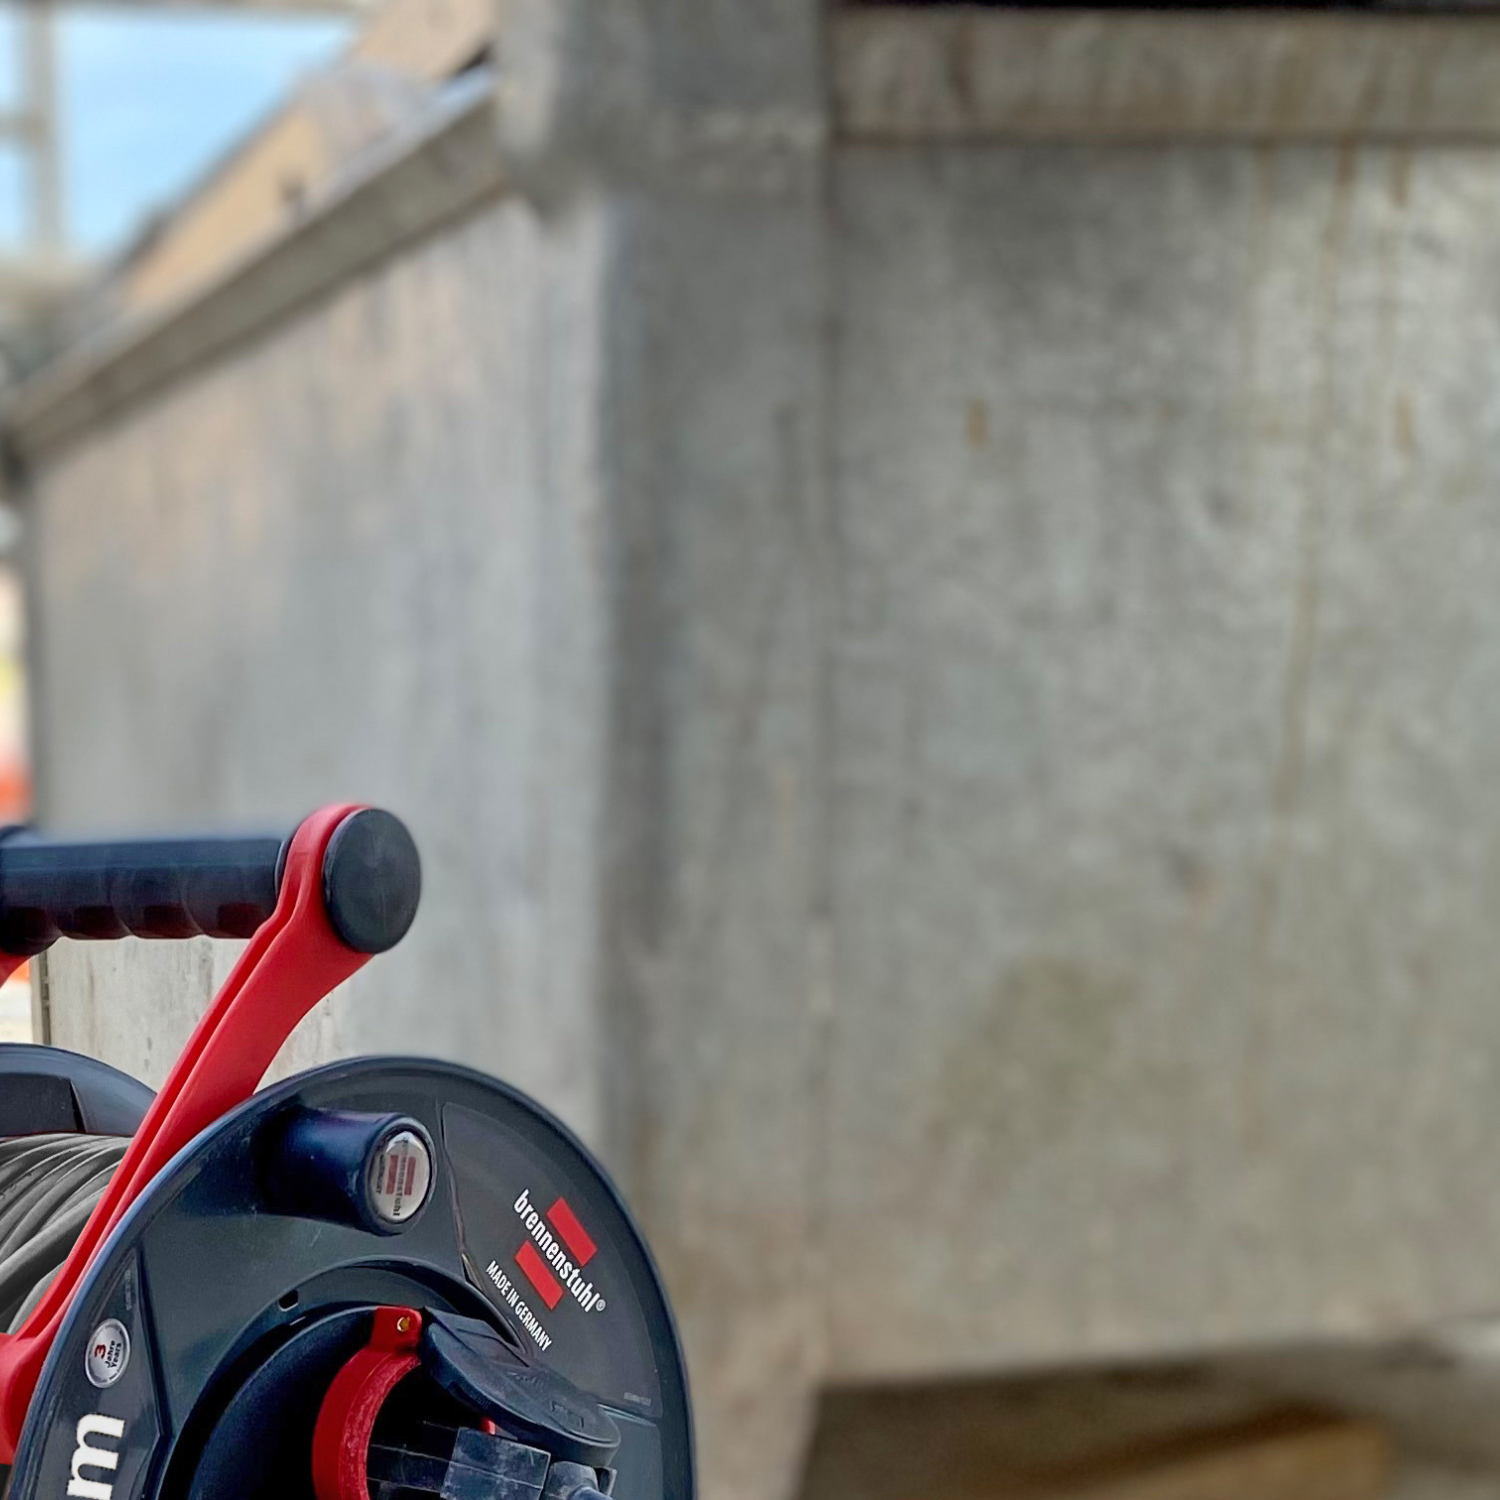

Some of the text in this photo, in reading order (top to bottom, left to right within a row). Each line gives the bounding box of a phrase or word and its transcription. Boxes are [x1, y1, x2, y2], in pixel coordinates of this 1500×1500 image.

[486, 1260, 512, 1296] MADE
[505, 1287, 520, 1308] IN
[514, 1301, 552, 1351] GERMANY
[94, 1344, 106, 1359] 3
[105, 1340, 115, 1368] Jahre
[110, 1342, 122, 1368] Years
